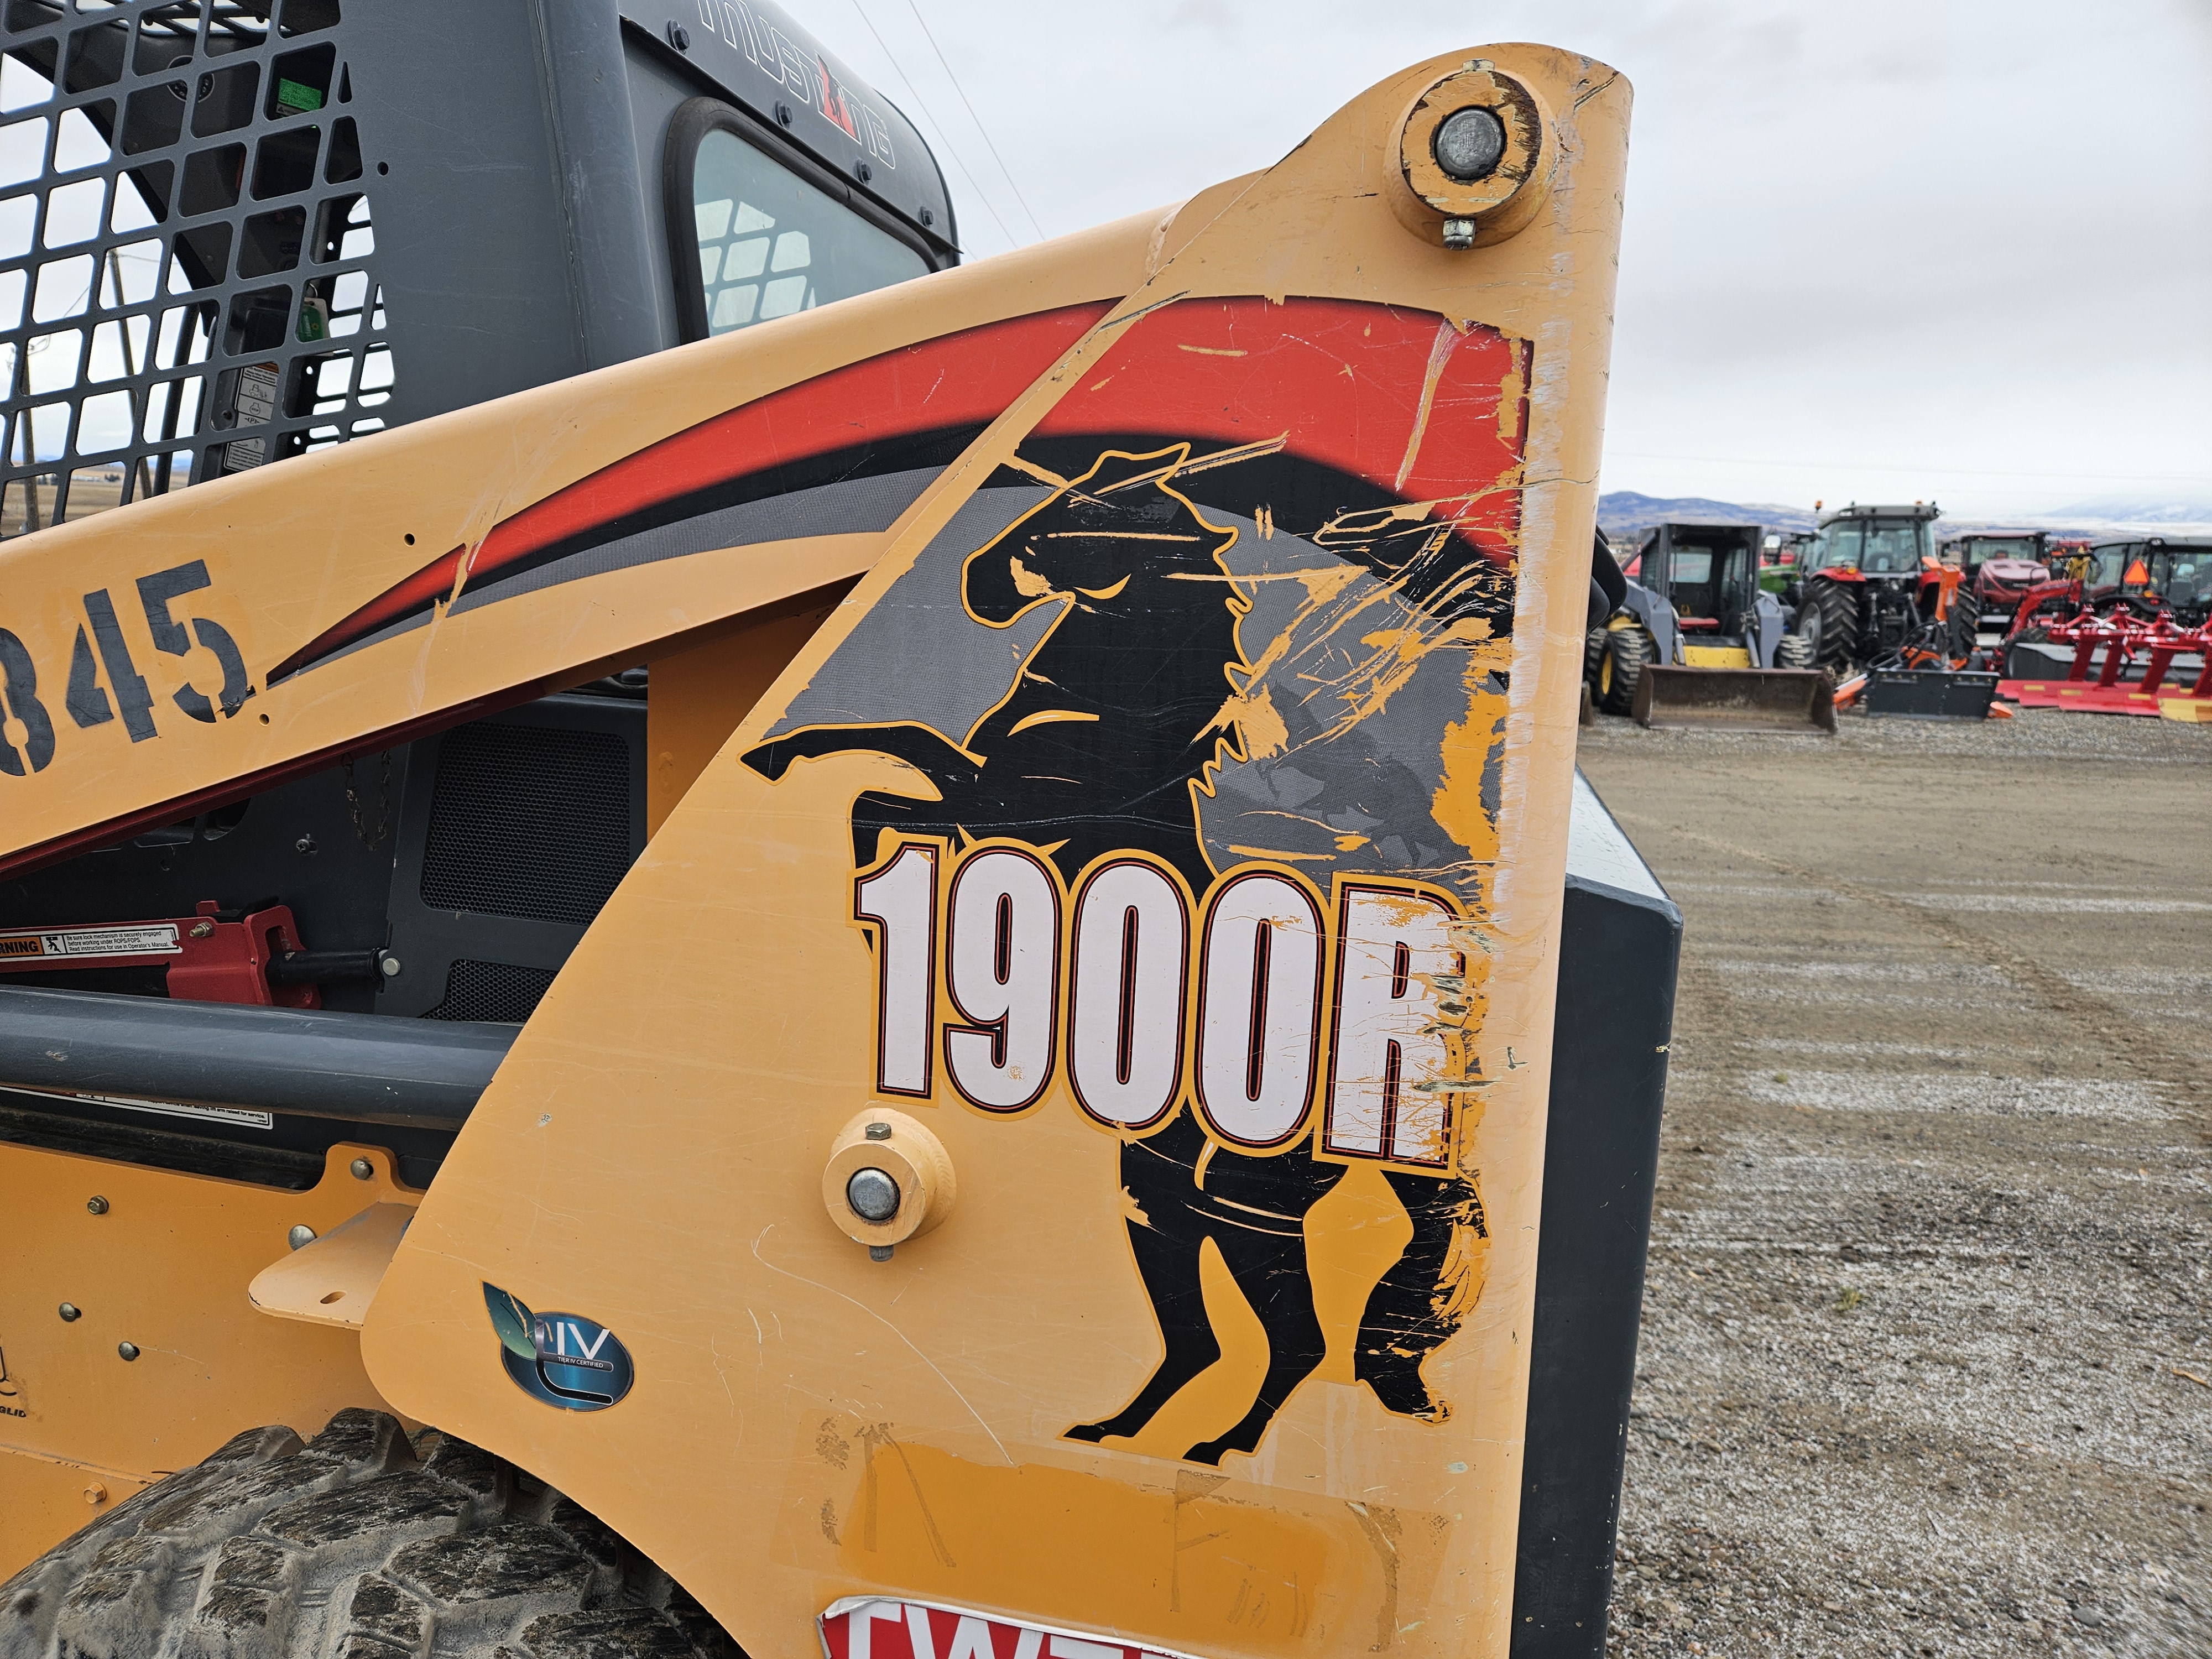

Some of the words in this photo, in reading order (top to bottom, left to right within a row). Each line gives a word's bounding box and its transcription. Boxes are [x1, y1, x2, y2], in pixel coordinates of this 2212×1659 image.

[854, 841, 1465, 1167] 1900R
[557, 1322, 611, 1360] IV
[576, 1359, 603, 1368] CERTIFIED
